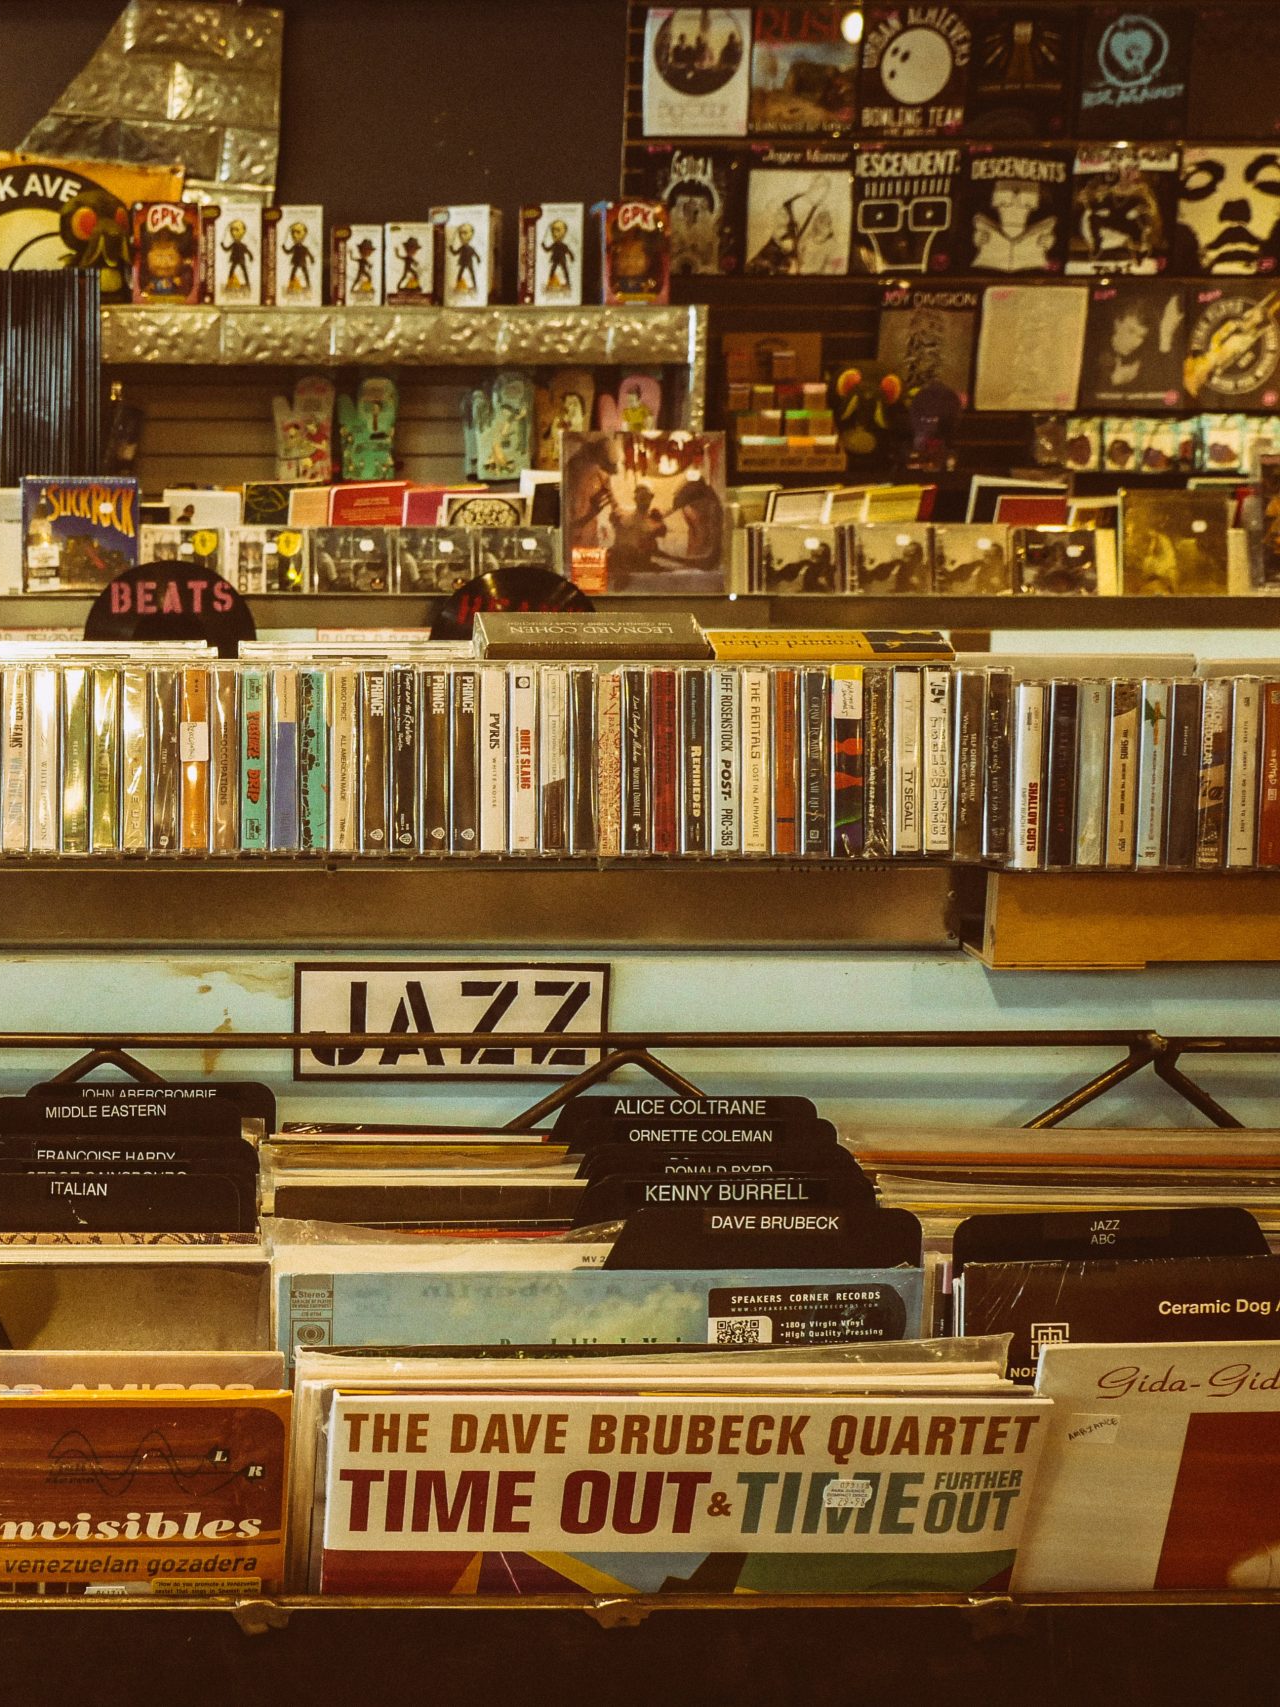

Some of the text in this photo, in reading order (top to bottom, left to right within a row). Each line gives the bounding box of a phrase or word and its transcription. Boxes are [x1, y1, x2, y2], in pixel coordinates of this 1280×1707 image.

[972, 156, 1066, 183] DESCENDENTS
[22, 172, 82, 203] AVE
[146, 204, 186, 232] GPK
[912, 293, 978, 307] DIVISION
[110, 580, 235, 615] BEATS
[508, 625, 674, 636] LEONARD COHEN
[721, 639, 862, 649] leonard cohen
[370, 676, 383, 717] PRINCE
[432, 675, 444, 715] PRINCE
[462, 675, 474, 714] PRINCE
[751, 681, 761, 759] THE RENTALS
[520, 729, 531, 789] QUIET SLANG
[720, 673, 733, 846] JEFF ROSENSTOCK POST- PRC-353
[904, 770, 913, 830] TY SEGALL
[1026, 782, 1039, 852] SHALLOW CUTS
[308, 980, 591, 1066] JAZZ
[81, 1088, 217, 1098] JOHN ABERCROMBIE
[45, 1104, 167, 1118] MIDDLE EASTERN
[614, 1100, 766, 1115] ALICE COLTRANE
[629, 1129, 772, 1143] ORNETTE COLEMAN
[665, 1165, 727, 1173] DONALD
[49, 1181, 108, 1197] ITALIAN
[645, 1183, 809, 1202] KENNY BURRELL
[711, 1216, 839, 1230] DAVE BRUBECK
[1090, 1219, 1120, 1231] JAZZ
[1091, 1233, 1116, 1245] ABC
[298, 1290, 326, 1299] Stereo
[731, 1291, 881, 1304] SPEAKERS CORNER RECORDS
[1158, 1298, 1272, 1315] Ceramic Dog
[785, 1320, 837, 1330] 180g Virgin
[809, 1328, 883, 1338] Quality Pressing
[343, 1414, 1040, 1465] THE DAVE BRUBECK QUARTET
[339, 1469, 1023, 1536] TIME OUT & TIME FURTHER OUT
[5, 1555, 139, 1575] venezuelan
[146, 1554, 257, 1578] gozadera
